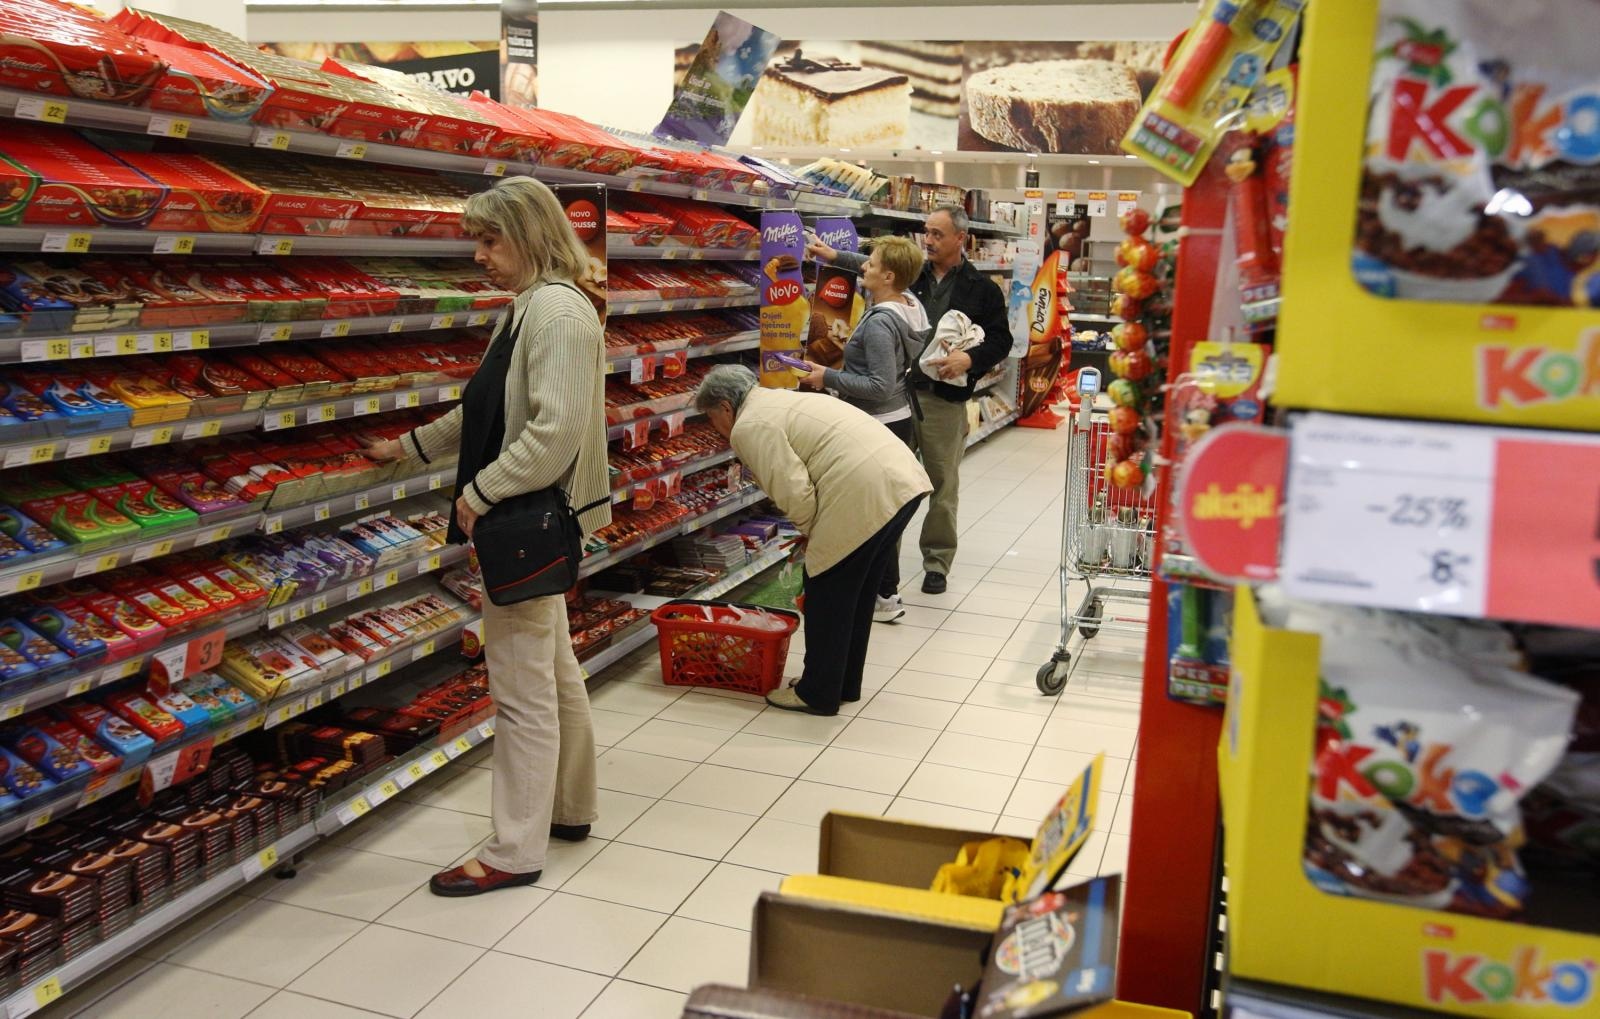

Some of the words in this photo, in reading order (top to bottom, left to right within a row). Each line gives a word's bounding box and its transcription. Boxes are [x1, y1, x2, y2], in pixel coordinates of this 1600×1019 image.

[275, 200, 307, 209] MIKADO
[570, 210, 591, 219] NOVO
[763, 223, 799, 243] Milka
[820, 228, 853, 246] Milka
[824, 289, 848, 299] Mousse
[830, 283, 845, 292] NOVO
[1030, 287, 1051, 334] Dorina
[1314, 725, 1500, 816] Koko
[1425, 946, 1591, 1006] Koko
